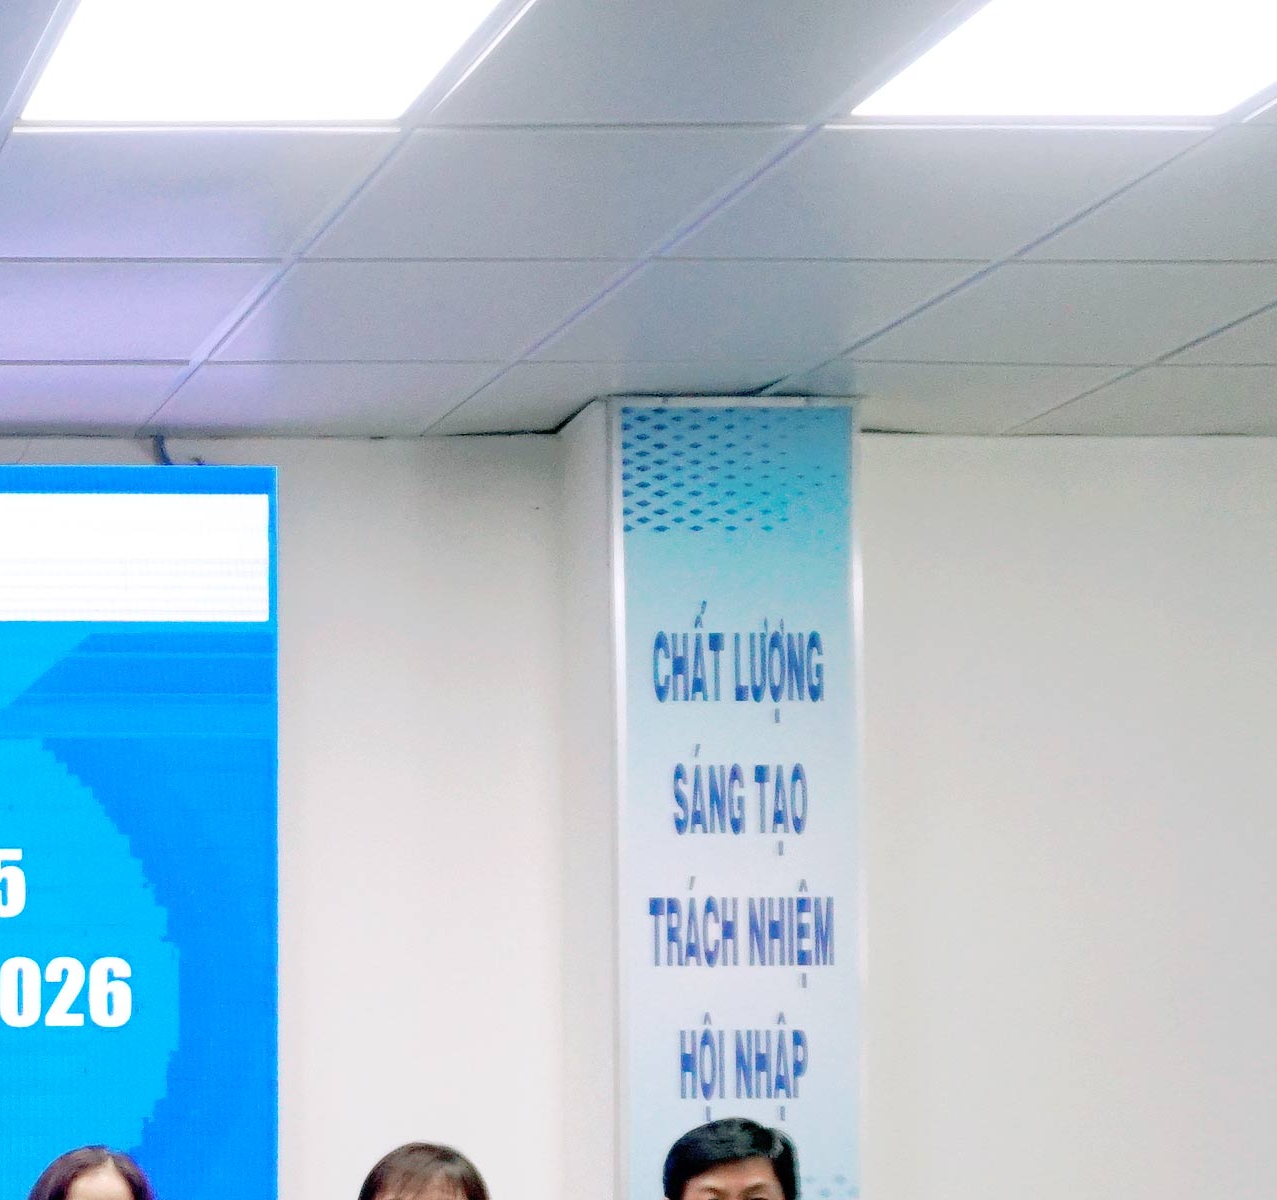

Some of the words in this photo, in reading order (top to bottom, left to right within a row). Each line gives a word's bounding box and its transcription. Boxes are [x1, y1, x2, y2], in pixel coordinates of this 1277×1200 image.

[653, 601, 725, 703] CHẤT
[735, 618, 825, 724] LƯỢNG
[673, 744, 745, 835] SÁNG
[754, 763, 808, 856] TẠO
[649, 876, 739, 967] TRÁCH
[748, 879, 835, 988] NHIỆM
[680, 1012, 725, 1121] HỘI
[736, 1012, 808, 1121] NHẬP
